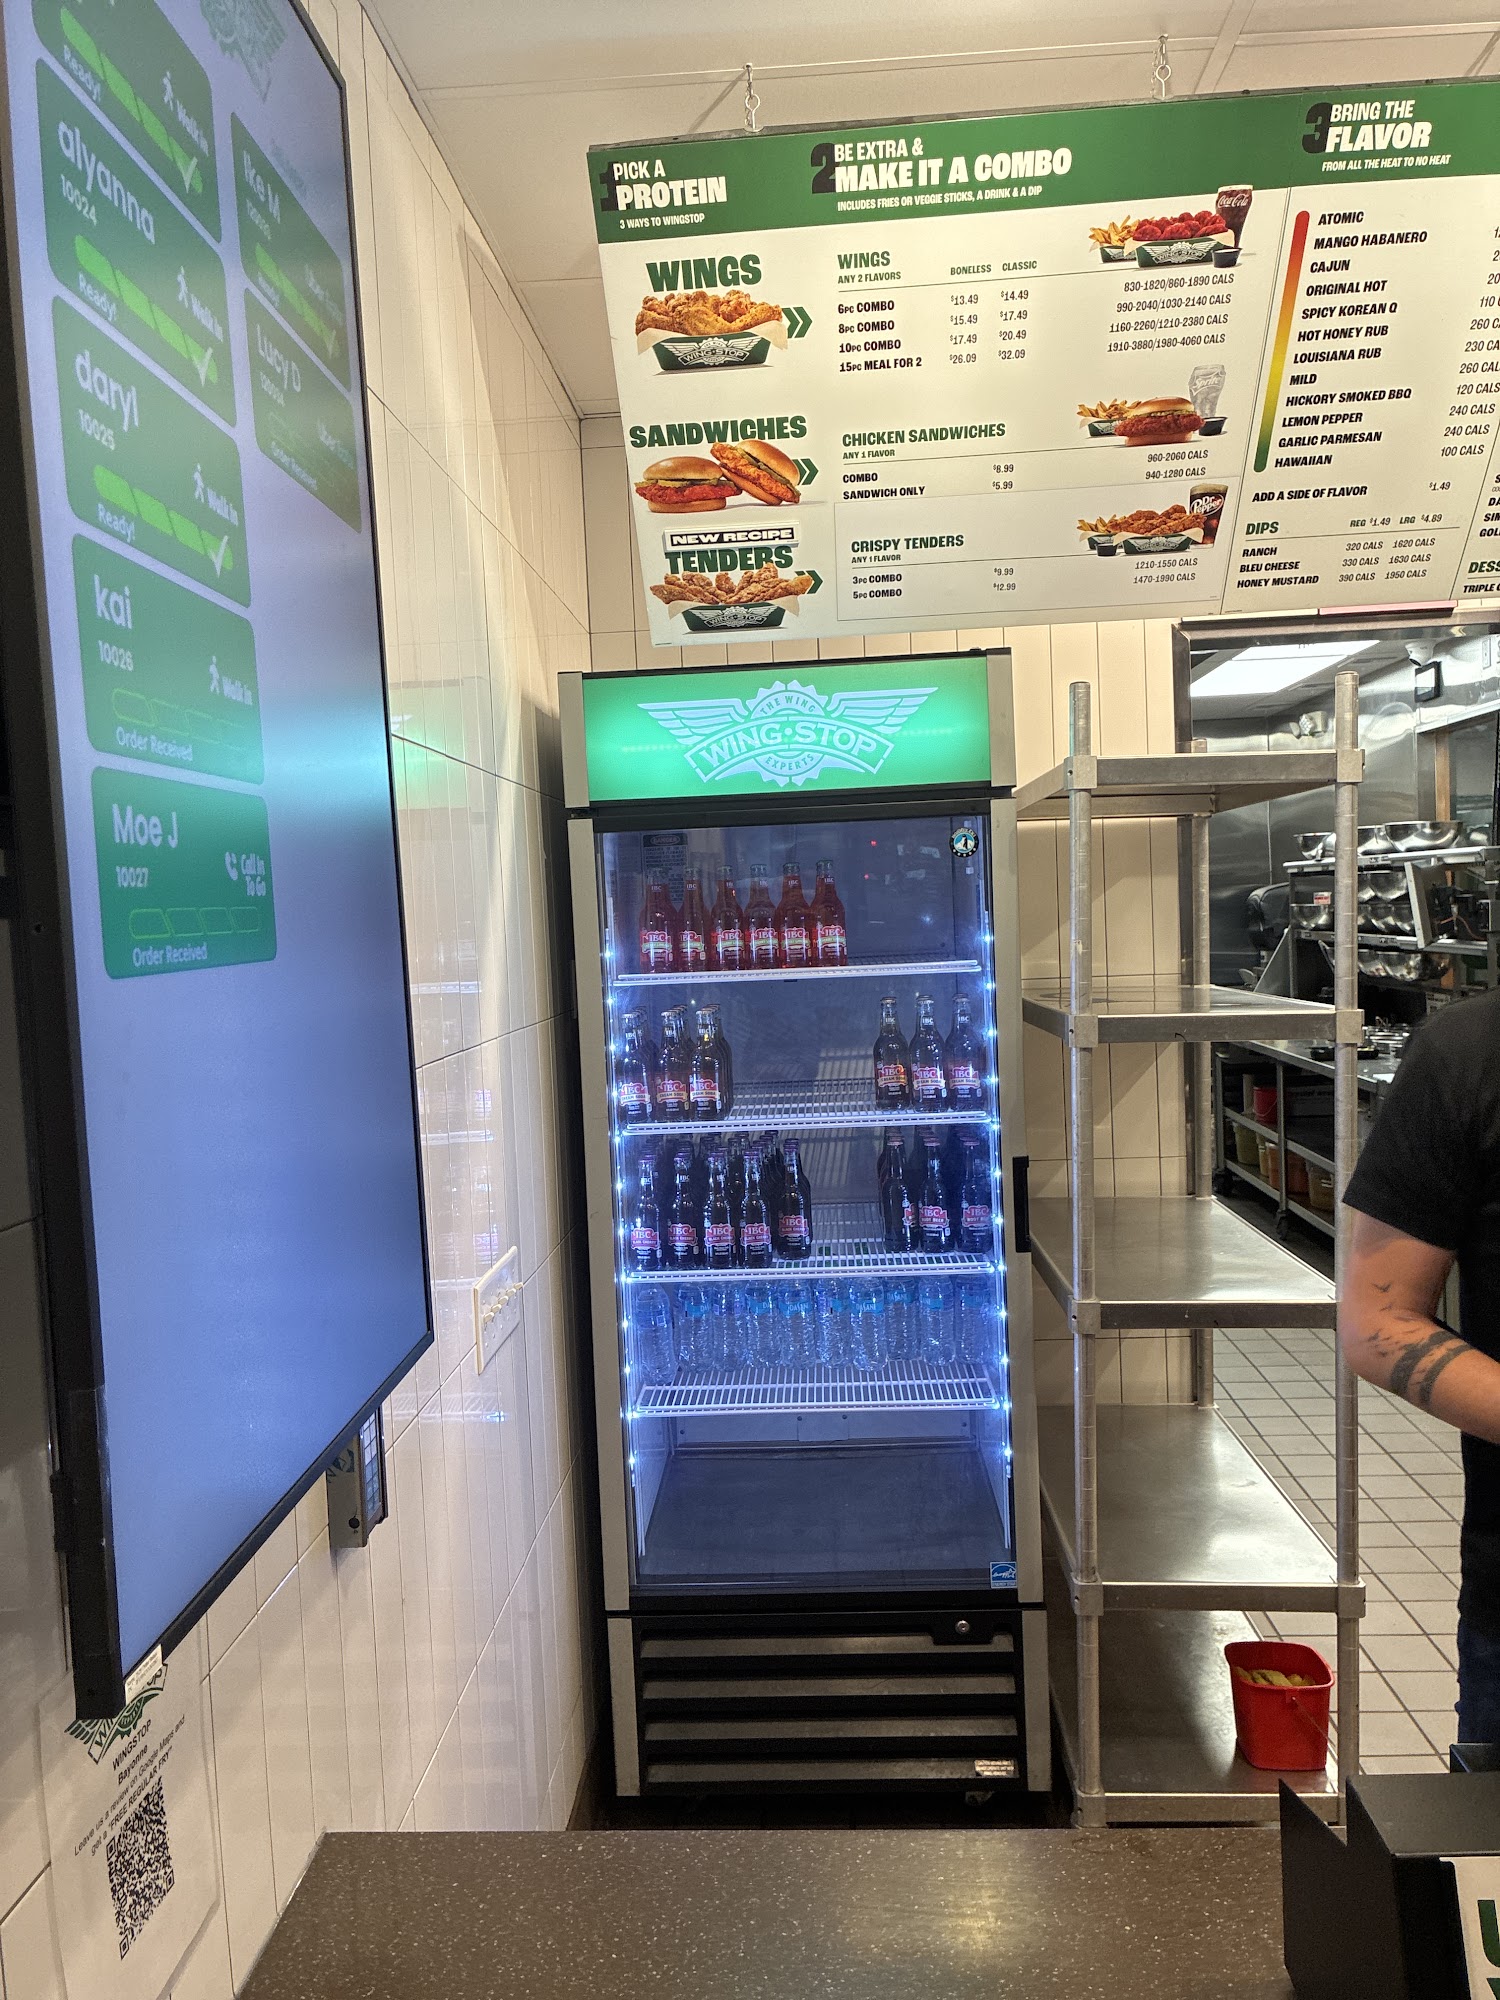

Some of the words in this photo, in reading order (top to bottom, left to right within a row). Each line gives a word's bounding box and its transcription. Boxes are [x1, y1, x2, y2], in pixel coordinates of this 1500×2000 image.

[1330, 102, 1381, 122] BRING
[1385, 100, 1415, 119] THE
[1302, 102, 1332, 154] 3
[1325, 122, 1432, 153] FLAVOR
[835, 143, 853, 162] BE
[857, 139, 908, 161] EXTRA
[912, 138, 923, 156] &
[613, 161, 649, 181] PICK
[654, 159, 666, 177] A
[810, 143, 837, 194] 2
[835, 162, 913, 192] MAKE
[919, 158, 943, 186] IT
[948, 157, 968, 184] A
[974, 148, 1072, 181] COMBO
[1322, 161, 1346, 171] FROM
[1347, 160, 1362, 170] ALL
[1364, 159, 1380, 169] THE
[1380, 158, 1402, 168] HEAT
[1404, 157, 1414, 166] TO
[1415, 156, 1428, 166] NO
[1429, 155, 1451, 165] HEAT
[57, 121, 155, 244] alyanna
[60, 175, 97, 226] 10024
[616, 176, 727, 211] PROTEIN
[838, 200, 876, 211] INCLUDES
[877, 198, 900, 209] FRIES
[901, 197, 913, 206] OR
[914, 195, 943, 206] VEGGIE
[944, 192, 975, 203] STICKS,
[977, 191, 983, 199] A
[985, 188, 1011, 200] DRINK
[1012, 188, 1018, 197] &
[1020, 188, 1027, 196] A
[1028, 186, 1042, 196] DIP
[620, 220, 625, 229] 3
[626, 218, 650, 229] WAYS
[651, 217, 661, 227] TO
[663, 213, 705, 226] WINGSTOP
[1318, 211, 1364, 225] ATOMIC
[1314, 236, 1359, 249] MANGO
[1361, 231, 1427, 246] HABANERO
[837, 251, 891, 270] WINGS
[1002, 260, 1037, 271] CLASSIC
[1310, 259, 1350, 273] CAJUN
[646, 254, 761, 292] WINGS
[838, 275, 856, 284] ANY
[858, 274, 863, 282] 2
[864, 271, 901, 283] FLAVORS
[950, 264, 991, 276] BONELESS
[1124, 275, 1209, 292] 830-1820/860-1890
[1212, 273, 1234, 285] CALS
[951, 294, 978, 305] $13.49
[1001, 290, 1029, 301] $14.49
[856, 300, 895, 312] COMBO
[1302, 306, 1336, 320] SPICY
[1338, 303, 1387, 317] KOREAN
[1389, 302, 1398, 314] Q
[1107, 335, 1201, 352] 1910-3880/1980-4060
[1203, 334, 1225, 344] CALS
[256, 324, 291, 390] Lucy
[864, 359, 891, 371] MEAL
[894, 358, 913, 368] FOR
[916, 357, 922, 366] 2
[949, 354, 976, 364] $26.09
[998, 350, 1026, 360] $32.09
[1289, 374, 1317, 385] MILD
[74, 349, 140, 432] daryl
[1286, 393, 1336, 407] HICKORY
[1338, 390, 1386, 403] SMOKED
[1388, 388, 1412, 401] BBQ
[1449, 406, 1468, 416] 240
[1470, 404, 1496, 415] CALS
[79, 409, 116, 451] 10025
[629, 415, 807, 448] SANDWICHES
[842, 430, 905, 447] CHICKEN
[908, 423, 1006, 443] SANDWICHES
[843, 452, 860, 460] ANY
[867, 449, 895, 458] FLAVOR
[1147, 452, 1186, 462] 960-2060
[1187, 450, 1208, 460] CALS
[1274, 454, 1332, 468] HAWAIIAN
[843, 473, 878, 483] COMBO
[1190, 497, 1222, 514] Pepper
[1202, 496, 1215, 505] Dr
[98, 503, 136, 542] Ready!
[1245, 522, 1279, 536] DIPS
[673, 533, 721, 546] NEW
[723, 529, 792, 543] RECIPE
[851, 539, 901, 553] CRISPY
[904, 535, 964, 550] TENDERS
[664, 546, 793, 574] TENDERS
[1242, 547, 1277, 558] RANCH
[1135, 559, 1178, 569] 1210-1550
[1179, 558, 1198, 567] CALS
[1240, 563, 1263, 573] BLEU
[1264, 561, 1300, 572] CHEESE
[869, 574, 902, 583] COMBO
[1237, 578, 1270, 588] HONEY
[1272, 575, 1320, 586] MUSTARD
[93, 574, 132, 630] kai
[760, 697, 782, 716] THE
[785, 695, 816, 713] WING
[116, 726, 149, 750] Order
[150, 734, 193, 762] Received
[765, 753, 814, 771] EXPERTS
[112, 803, 162, 847] Moe
[168, 811, 179, 848] J
[116, 866, 149, 887] 10027
[825, 929, 840, 937] IBC
[133, 946, 164, 967] Order
[166, 942, 208, 962] Received
[786, 1218, 800, 1226] IBC
[112, 1719, 152, 1771] WINGSTOP
[118, 1745, 148, 1785] Bayonne
[74, 1827, 95, 1856] Leave
[95, 1818, 103, 1831] us
[110, 1787, 130, 1814] review
[130, 1776, 138, 1789] on
[139, 1749, 159, 1779] Google
[159, 1730, 174, 1753] Maps
[175, 1714, 185, 1733] and
[91, 1837, 102, 1857] get
[128, 1767, 158, 1806] REGULAR
